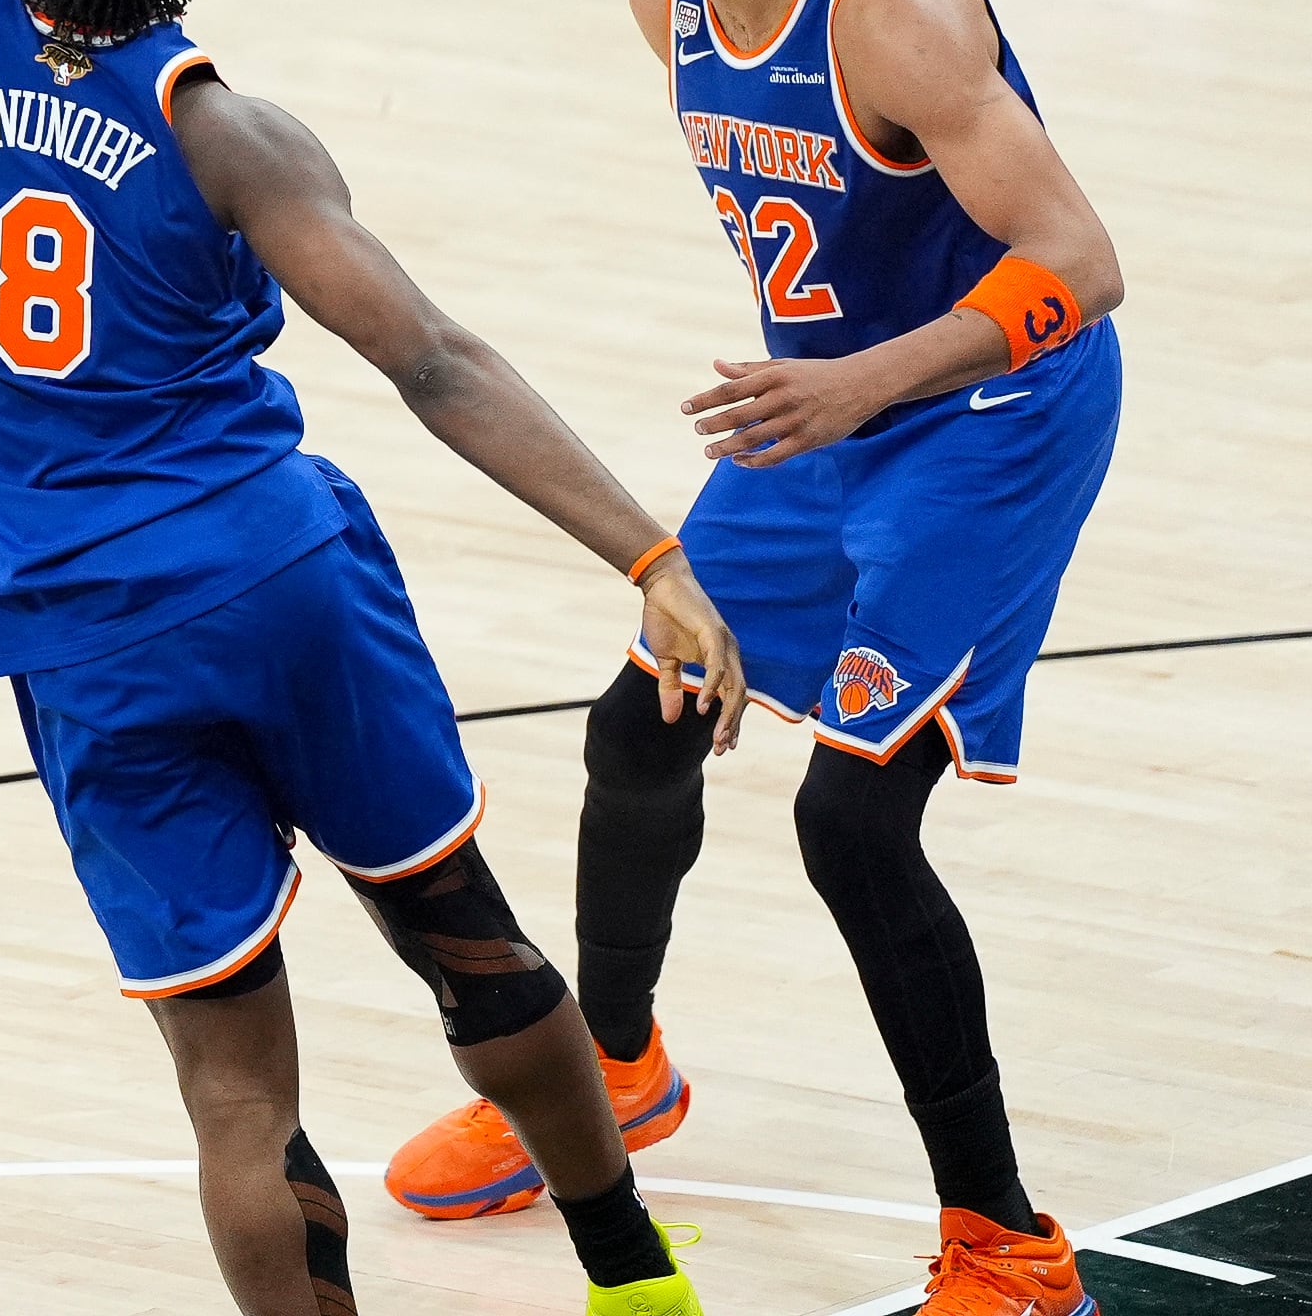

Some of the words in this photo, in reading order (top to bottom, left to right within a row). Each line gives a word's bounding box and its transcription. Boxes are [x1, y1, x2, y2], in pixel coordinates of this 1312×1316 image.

[769, 72, 790, 84] abu
[791, 72, 825, 85] dhabi
[681, 111, 733, 172] NEW
[731, 117, 847, 193] YORK
[712, 185, 844, 323] 32
[836, 651, 894, 703] KNICKS
